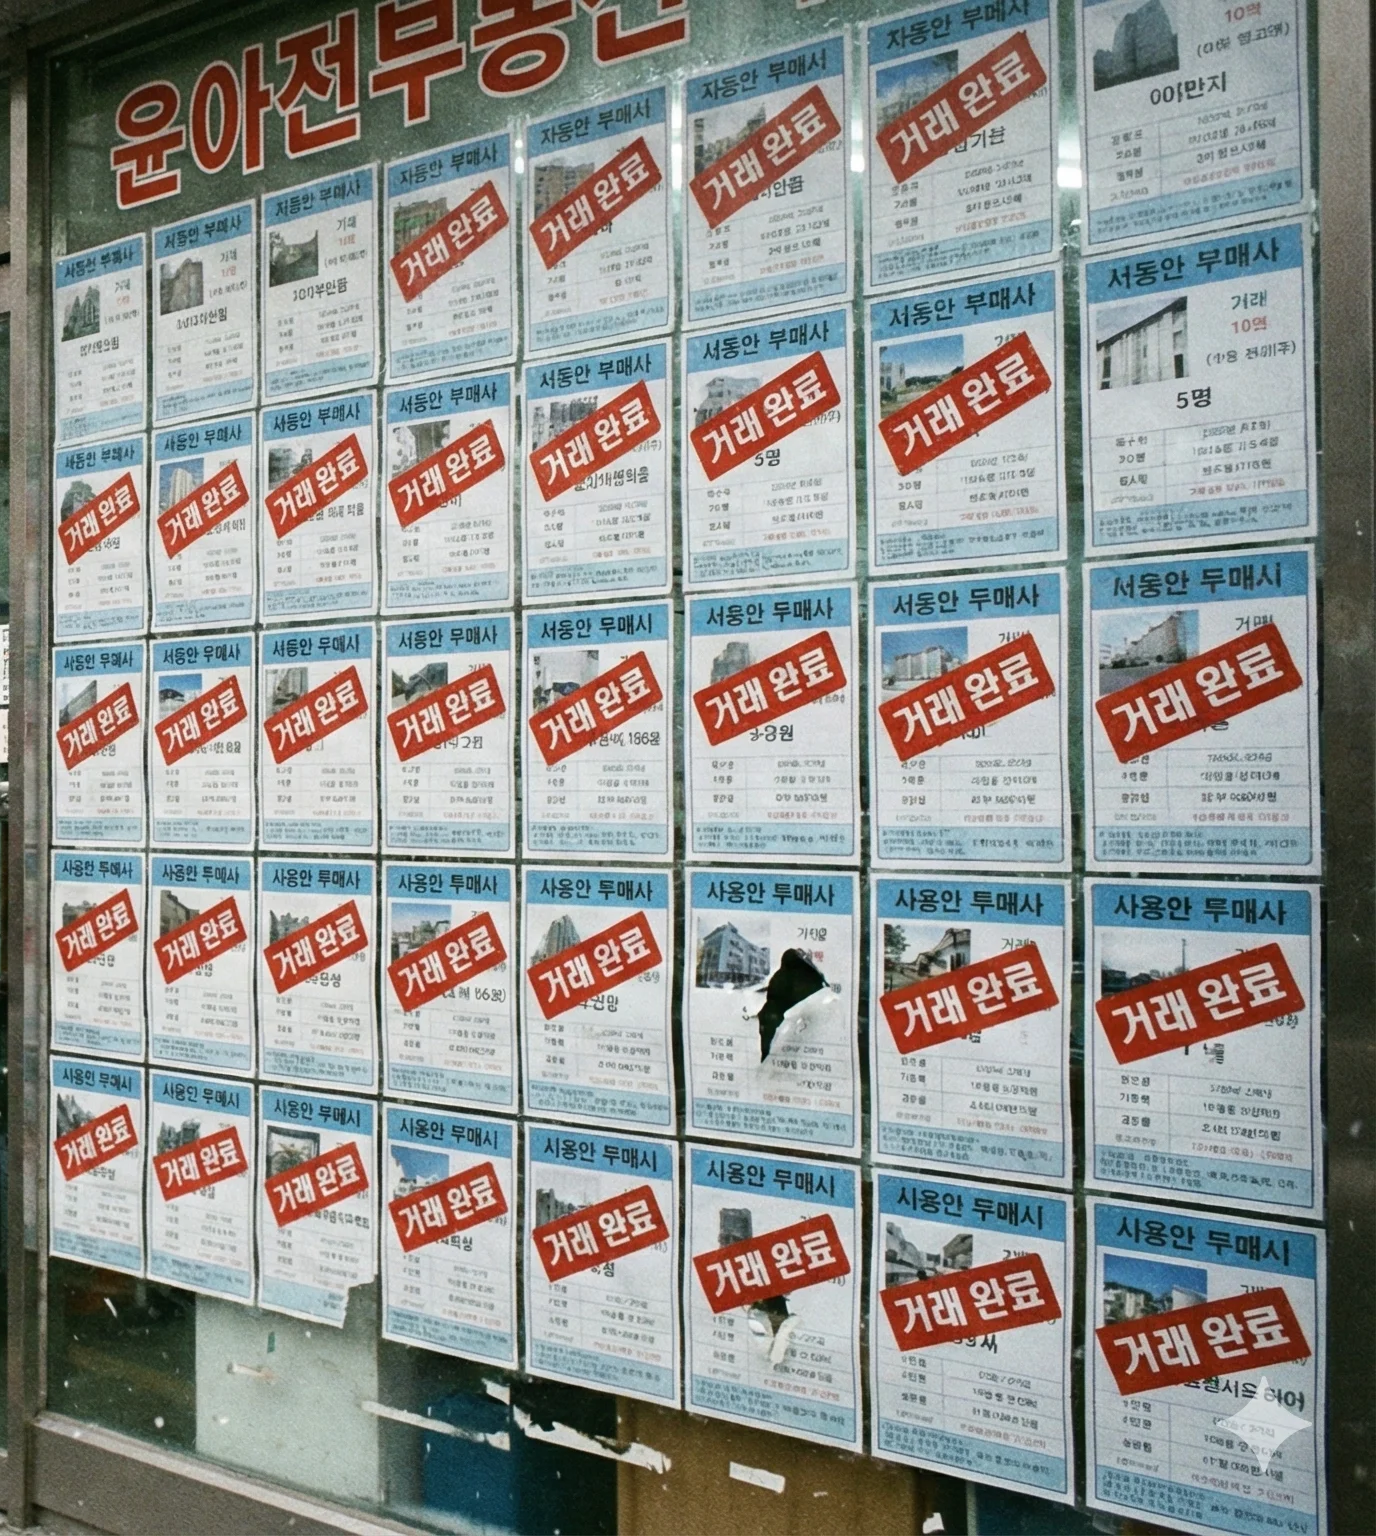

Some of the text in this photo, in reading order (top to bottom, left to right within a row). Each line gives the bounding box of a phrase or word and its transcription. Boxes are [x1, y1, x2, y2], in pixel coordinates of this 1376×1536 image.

[890, 50, 1031, 165] 거래 완료
[703, 103, 827, 210] 거래 완료
[540, 152, 650, 252] 거래 완료
[400, 195, 498, 286] 거래 완료
[1107, 253, 1186, 292] 서동안
[702, 369, 827, 464] 거래 완료
[892, 351, 1035, 456] 거래 완료
[1176, 386, 1212, 410] 5명
[397, 433, 496, 513] 거래 완료
[539, 397, 650, 486] 거래 완료
[273, 447, 360, 525] 거래 완료
[164, 500, 204, 546] 거래
[893, 589, 959, 617] 서동안
[271, 679, 359, 751] 거래 완료
[395, 678, 496, 748] 거래 완료
[539, 666, 651, 750] 거래 완료
[705, 647, 834, 729] 거래 완료
[892, 651, 1039, 743] 거래 완료
[1111, 642, 1284, 742] 거래 완료
[162, 711, 202, 753] 거래
[707, 880, 835, 907] 사용안 투매사
[895, 887, 1044, 918] 사용안 투매사
[1114, 893, 1193, 922] 사용안
[161, 929, 201, 970] 거래
[272, 913, 360, 980] 거래 완료
[397, 950, 447, 997] 거래
[444, 925, 496, 974] 완료
[538, 926, 651, 1003] 거래 완료
[894, 960, 1043, 1037] 거래 완료
[1111, 962, 1287, 1045] 거래 완료
[160, 1152, 201, 1188] 거래
[273, 1154, 360, 1213] 거래 완료
[896, 1186, 964, 1218] 시용안
[398, 1174, 497, 1238] 거래 완료
[542, 1199, 657, 1266] 거래 완료
[706, 1230, 837, 1297] 거래 완료
[894, 1269, 1045, 1334] 거래 완료
[1114, 1305, 1290, 1375] 거래 완료
